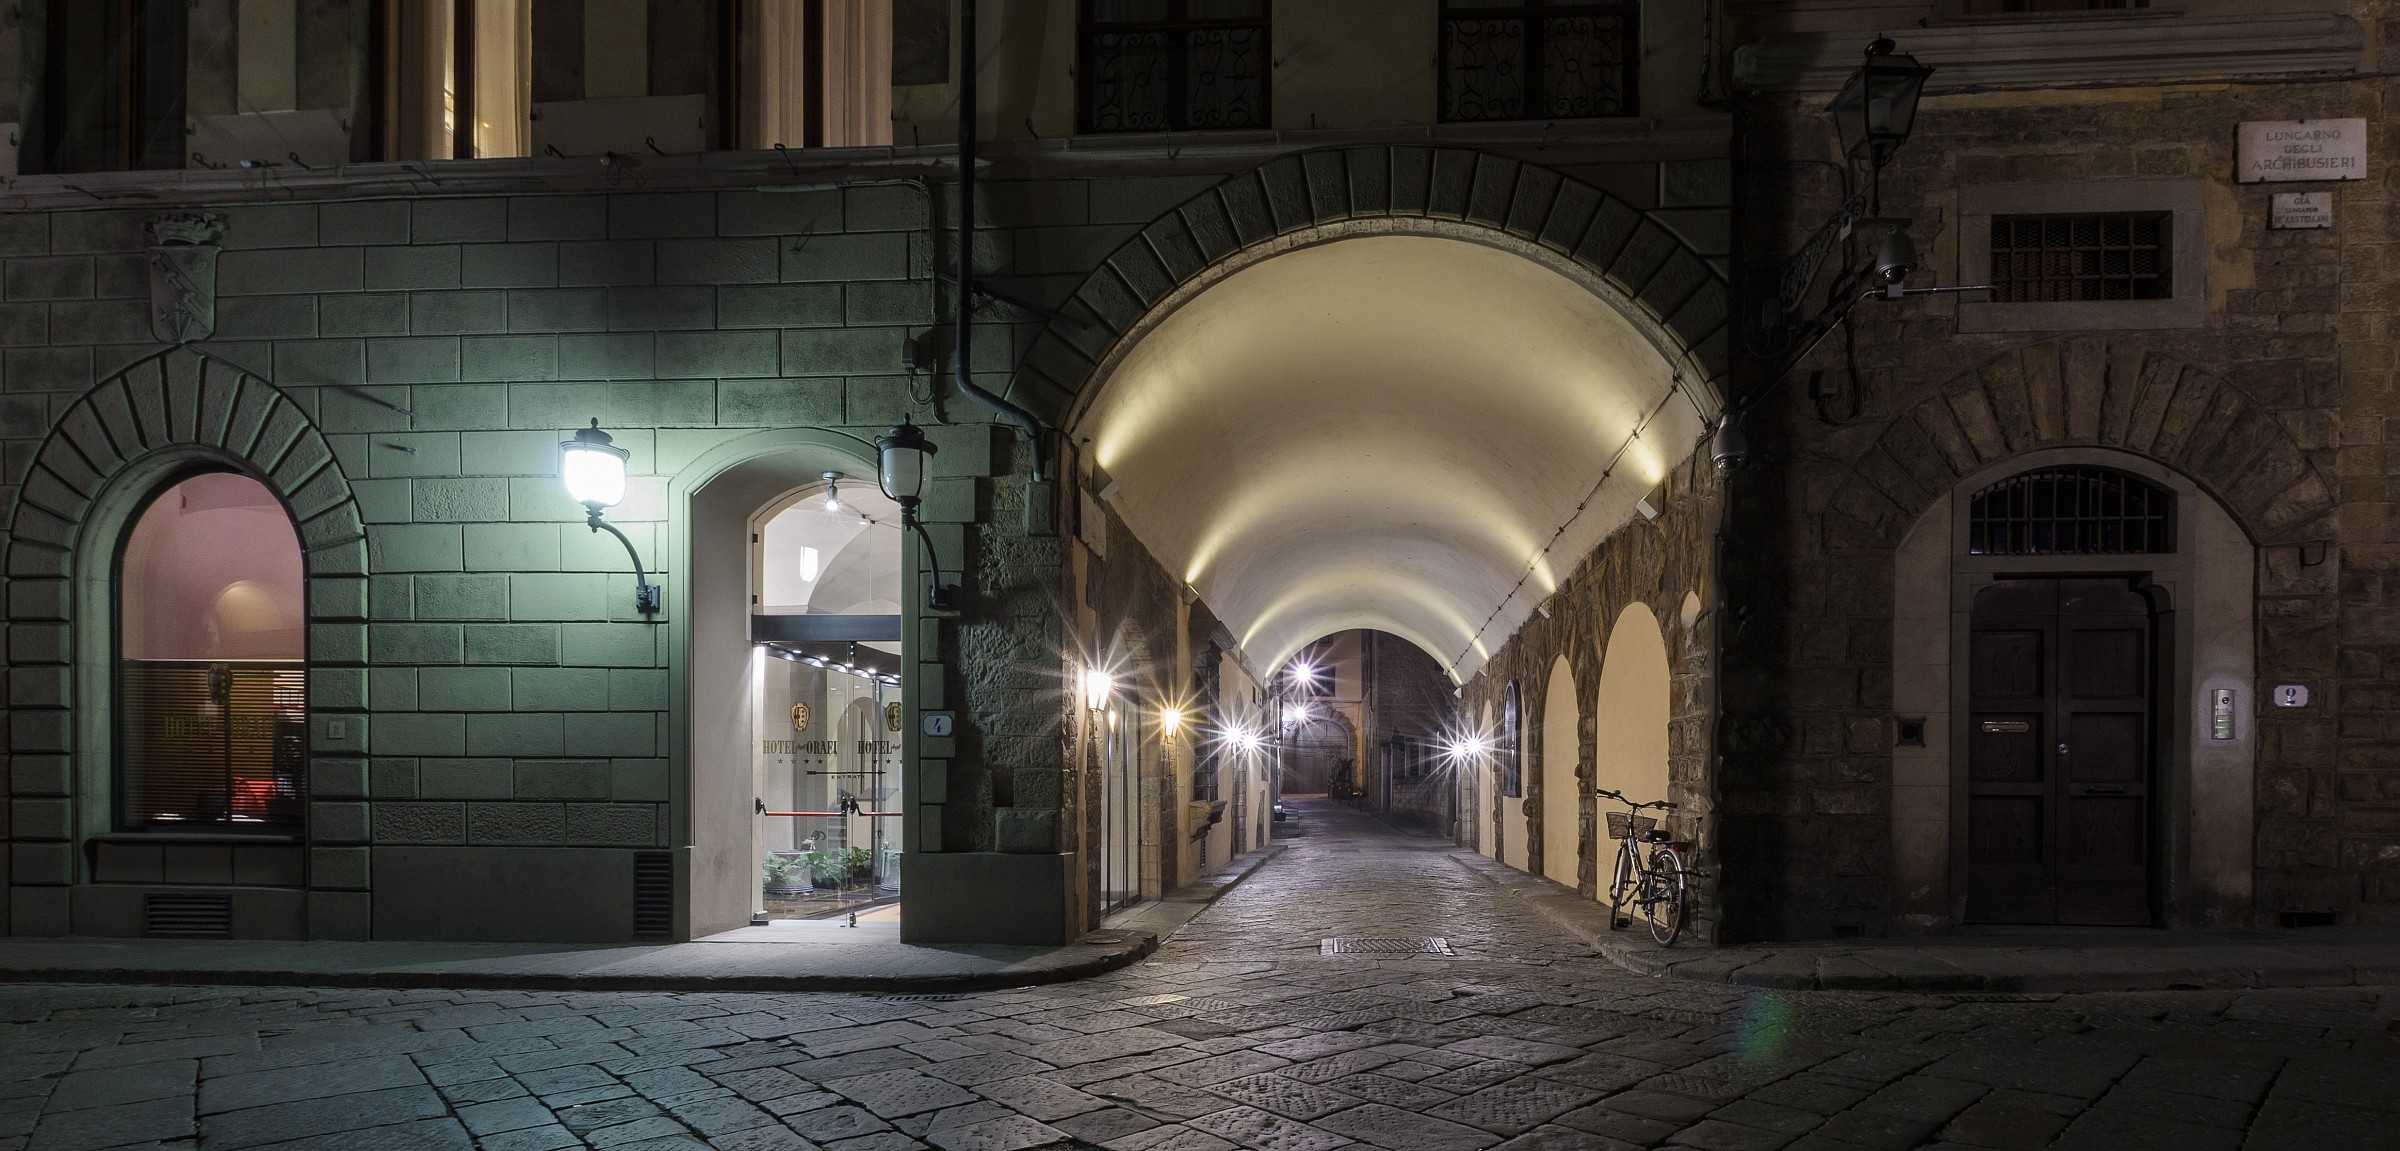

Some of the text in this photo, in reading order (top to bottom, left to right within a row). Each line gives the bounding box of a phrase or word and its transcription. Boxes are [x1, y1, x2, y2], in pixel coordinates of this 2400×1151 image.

[2266, 130, 2341, 142] LUNGARNO
[2284, 144, 2323, 154] DEGLI
[2252, 156, 2355, 170] ARCHIBUSIERI
[2285, 687, 2297, 705] 2
[932, 717, 943, 733] 4
[763, 740, 797, 754] HOTEL
[806, 740, 837, 754] ORAFI
[857, 740, 892, 754] HOTEL
